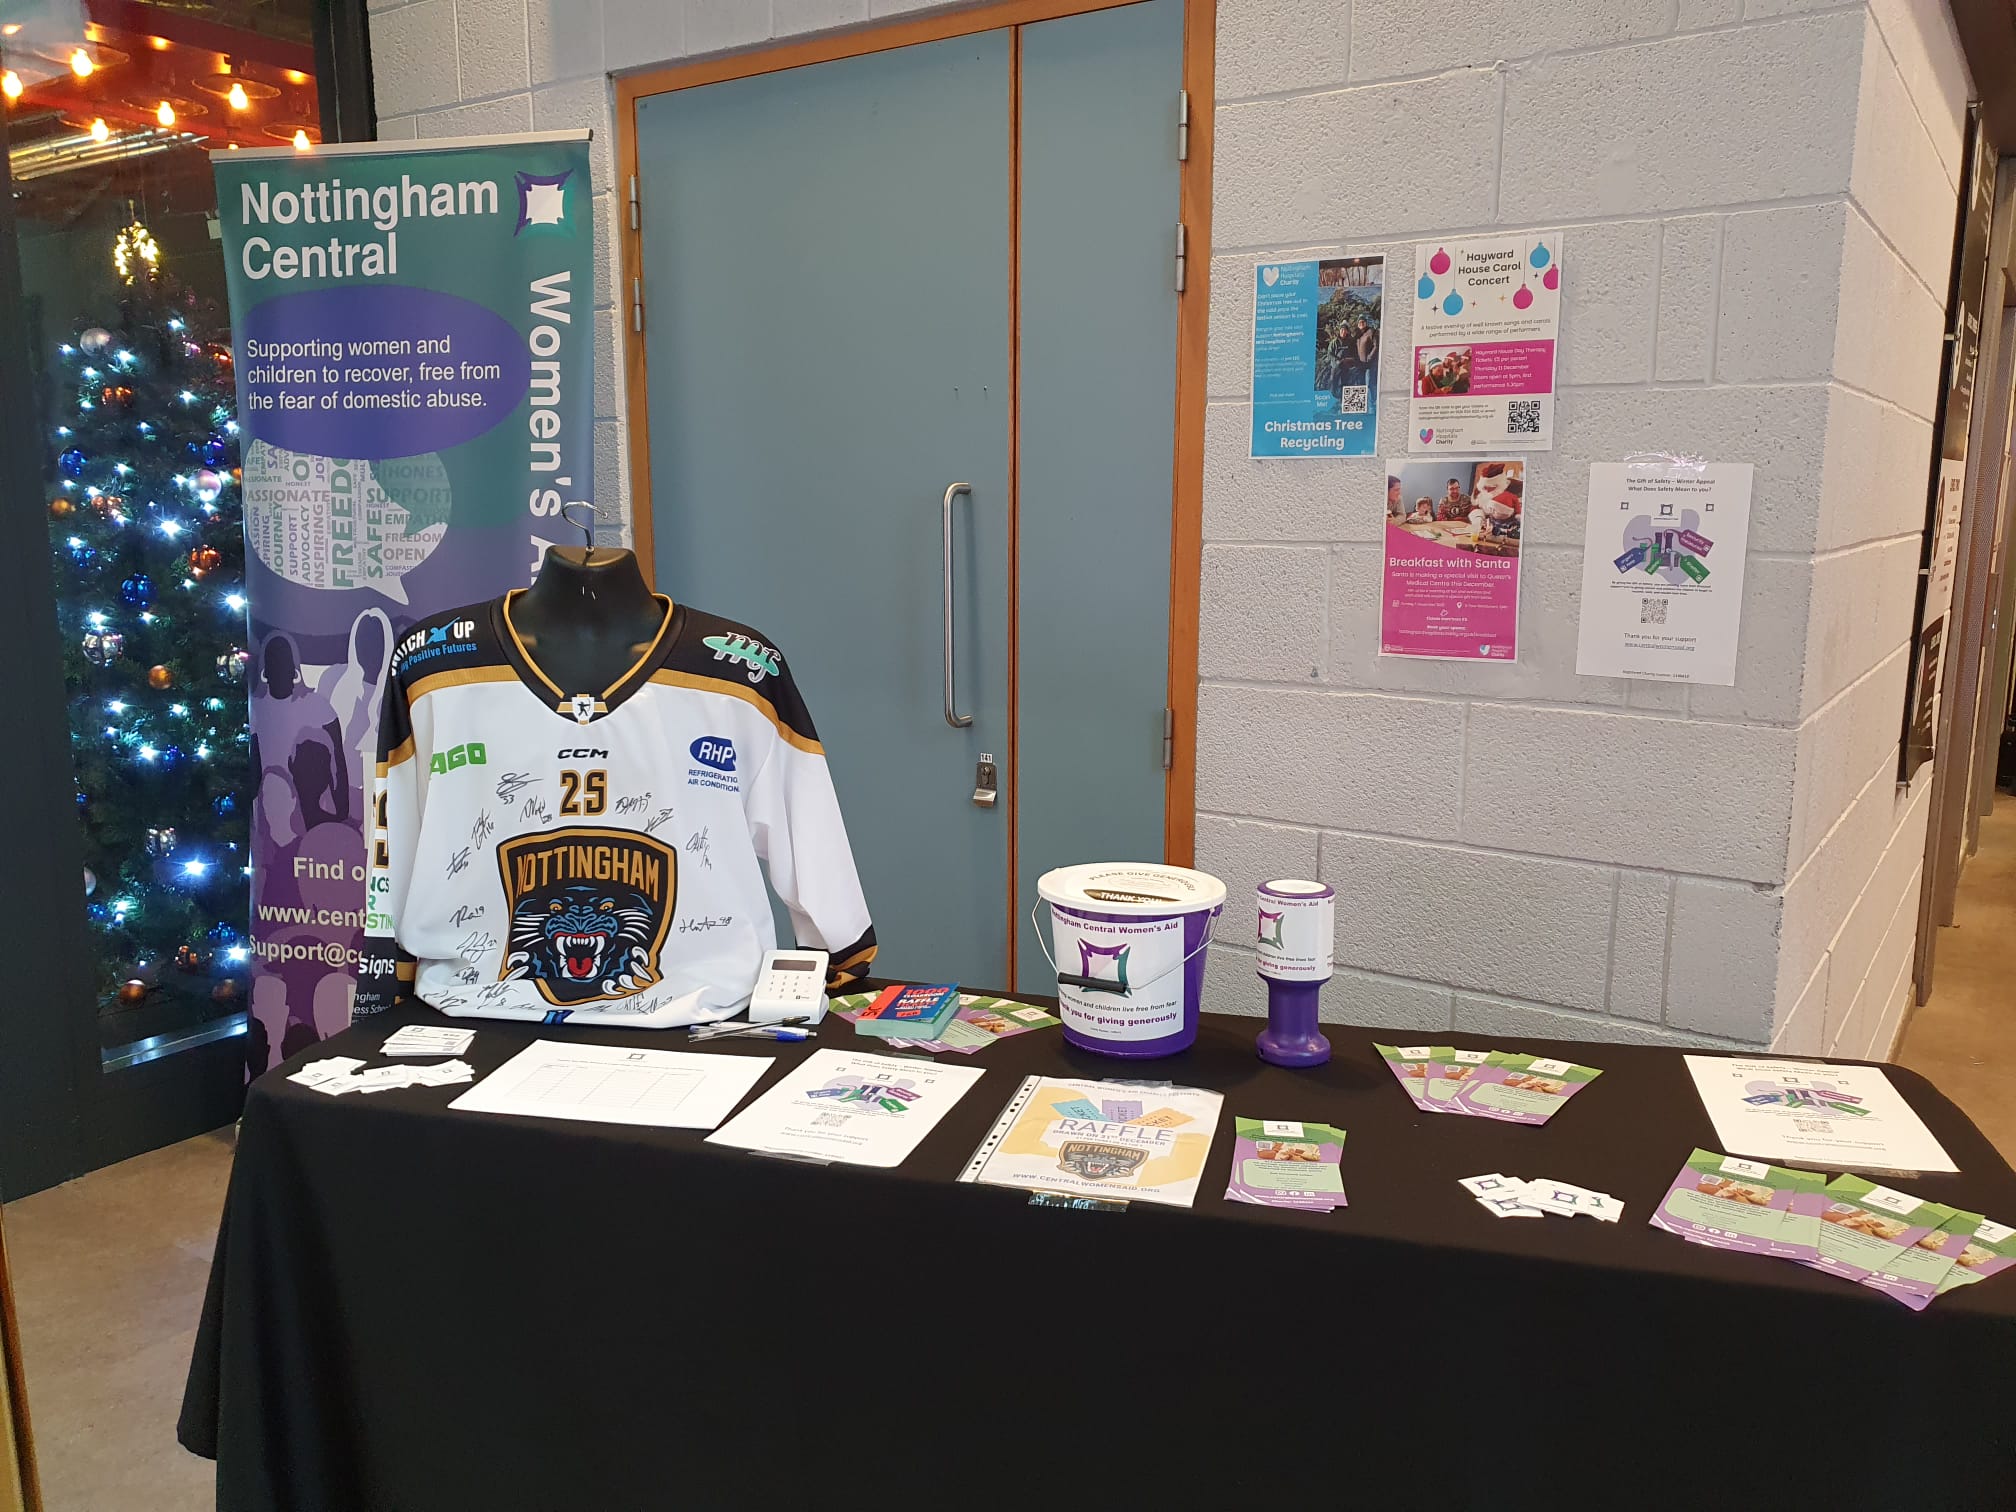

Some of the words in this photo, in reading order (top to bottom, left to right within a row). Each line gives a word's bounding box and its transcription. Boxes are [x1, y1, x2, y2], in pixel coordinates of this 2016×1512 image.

[241, 175, 498, 230] Nottingham
[243, 233, 398, 280] Central
[1467, 249, 1514, 263] Hayward
[1458, 266, 1491, 274] House
[1493, 262, 1521, 272] Carol
[1468, 276, 1510, 286] Concert
[248, 338, 343, 360] Supporting
[348, 339, 410, 356] women
[417, 335, 451, 354] and
[248, 365, 316, 384] children
[322, 367, 339, 383] to
[345, 367, 413, 384] recover,
[419, 363, 455, 381] free
[461, 362, 500, 380] from
[249, 392, 273, 409] the
[280, 392, 315, 409] fear
[321, 390, 338, 408] of
[343, 390, 420, 409] domestic
[427, 390, 487, 407] abuse.
[529, 271, 572, 518] Women's
[1265, 420, 1331, 432] Christmas
[1335, 420, 1363, 430] Tree
[1281, 436, 1344, 451] Recycling
[289, 514, 298, 576] SUPPORT
[300, 505, 310, 582] ADVOCACY
[313, 504, 325, 587] INSPIRING
[367, 509, 383, 578] SAFE
[385, 532, 441, 543] FREEDOM
[383, 548, 425, 561] OPEN
[1390, 558, 1443, 567] Breakfast
[1447, 558, 1472, 568] with
[1475, 558, 1511, 569] Santa
[453, 621, 475, 639] UP
[409, 647, 441, 666] Positive
[442, 642, 477, 655] Futures
[557, 748, 609, 760] CCM
[699, 741, 735, 765] RHP
[293, 856, 344, 881] Find
[516, 845, 660, 902] NOTTINGHAM
[1088, 871, 1124, 881] PLEASE
[1100, 891, 1136, 901] THANK
[1084, 922, 1116, 934] Central
[1120, 924, 1161, 934] Women's
[1164, 922, 1178, 931] Aid
[1263, 961, 1278, 969] giving
[1071, 1008, 1082, 1018] you
[1084, 1013, 1095, 1021] for
[1097, 1016, 1125, 1026] giving
[1128, 1012, 1177, 1026] generously
[1052, 1129, 1084, 1138] DRAWN
[1119, 1135, 1166, 1146] DECEMBER
[1059, 1119, 1176, 1142] RAFFLE
[1068, 1143, 1141, 1160] NOTTINGHAM
